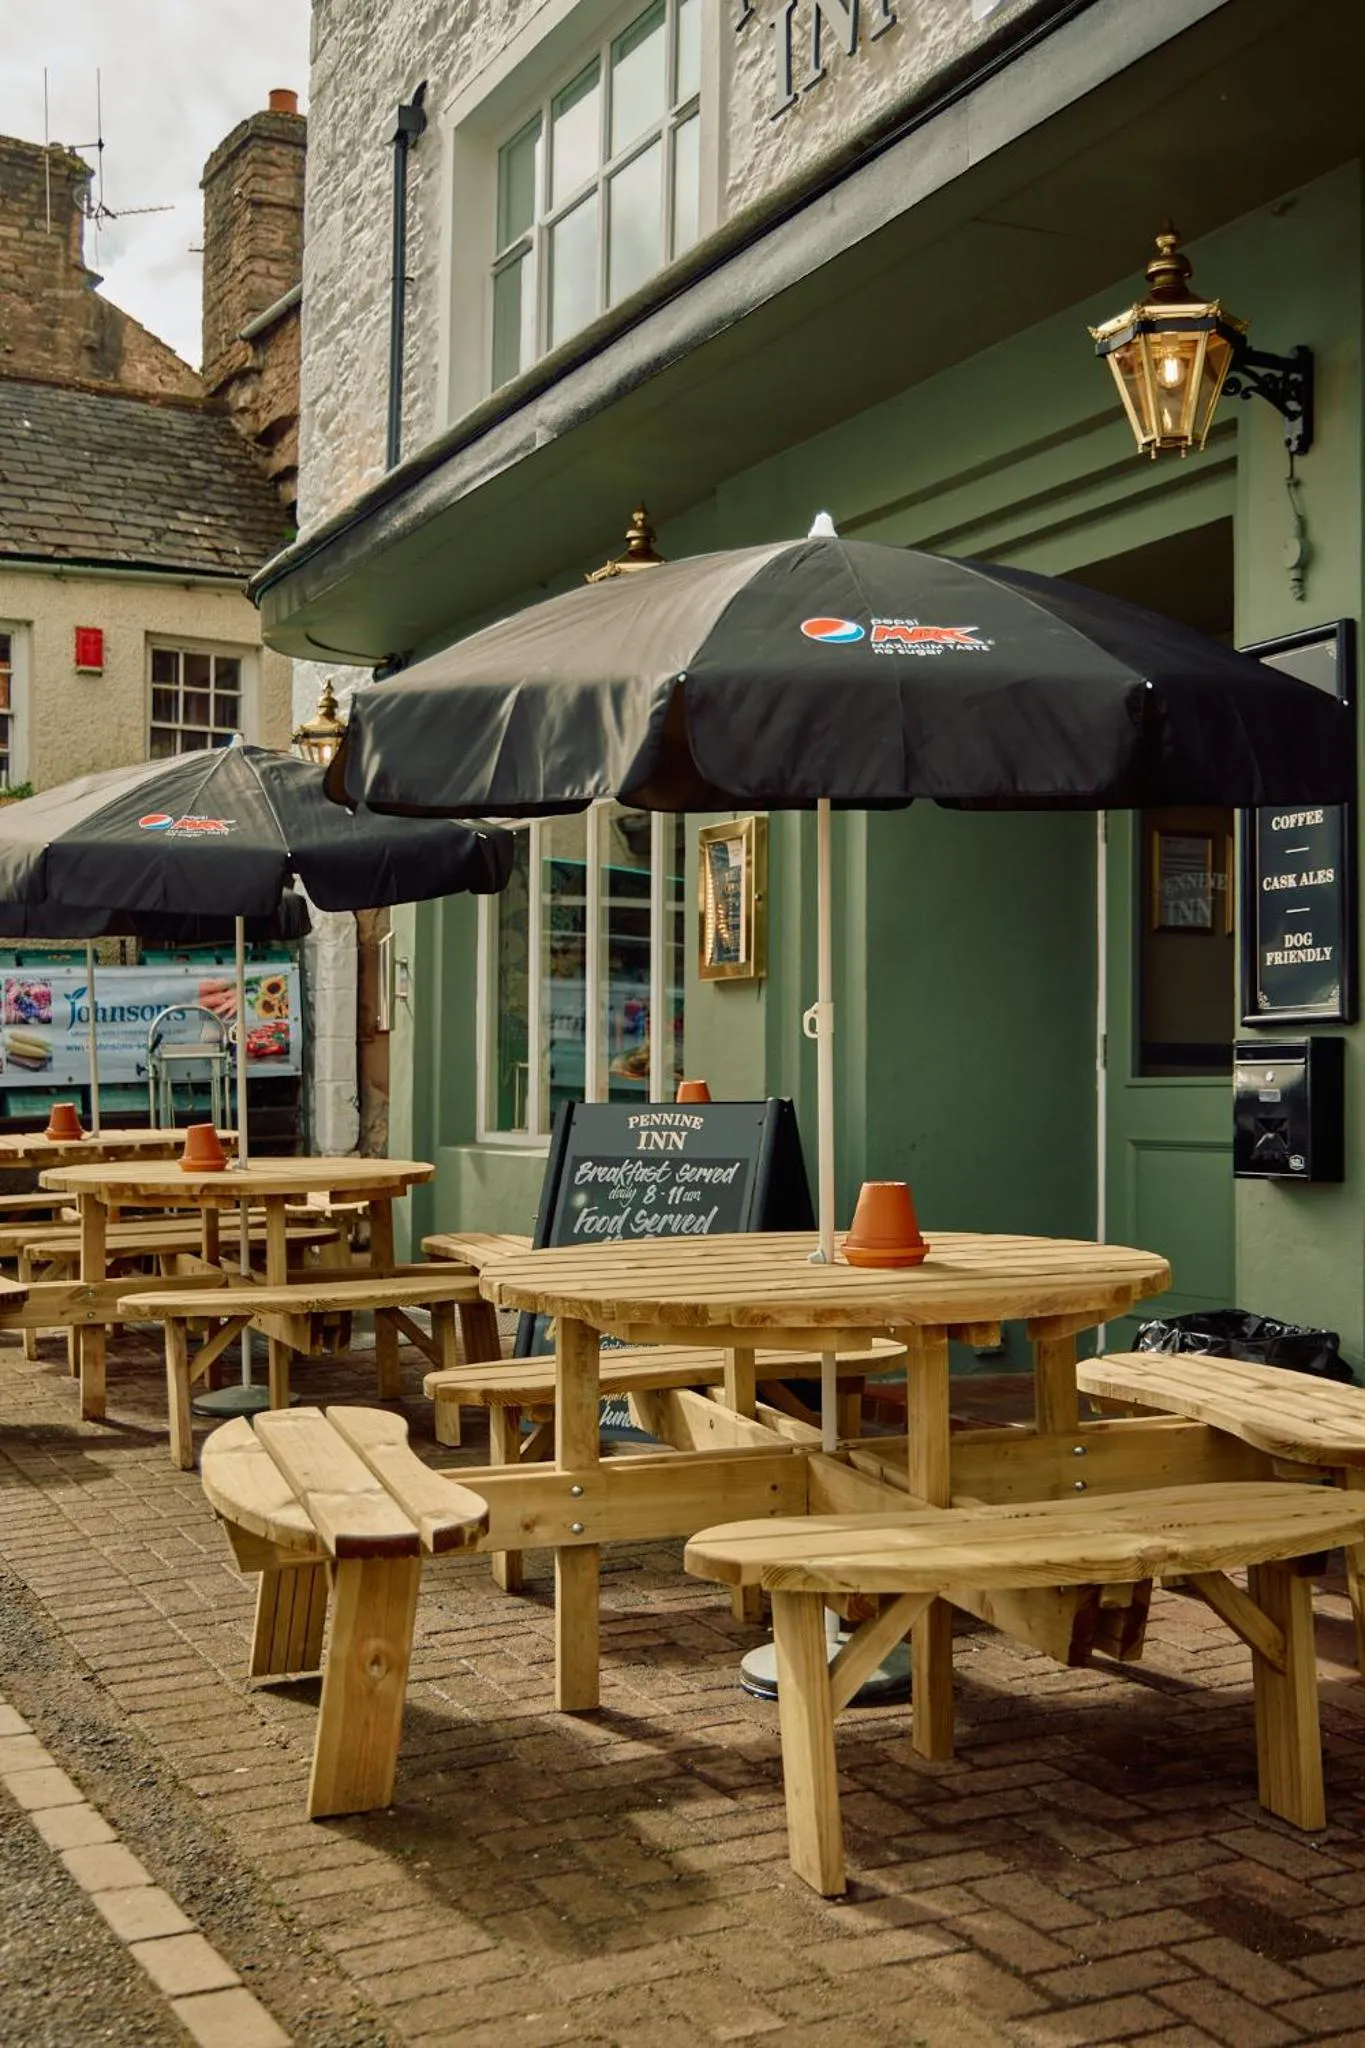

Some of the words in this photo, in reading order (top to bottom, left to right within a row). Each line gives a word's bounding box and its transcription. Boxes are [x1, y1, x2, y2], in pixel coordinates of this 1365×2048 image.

[871, 643, 945, 651] MAXIMUM
[947, 644, 991, 652] TASTE
[898, 649, 943, 657] sugar
[1271, 809, 1324, 831] COFFEE
[1262, 873, 1298, 891] CASK
[1300, 868, 1335, 886] ALES
[1284, 932, 1313, 948] DOG
[1266, 946, 1333, 966] FRIENDLY
[628, 1113, 704, 1130] PENNINE
[636, 1131, 688, 1150] INN
[574, 1159, 673, 1187] Breakfast
[608, 1184, 637, 1208] daily
[643, 1185, 657, 1204] 8
[573, 1206, 632, 1234] Food
